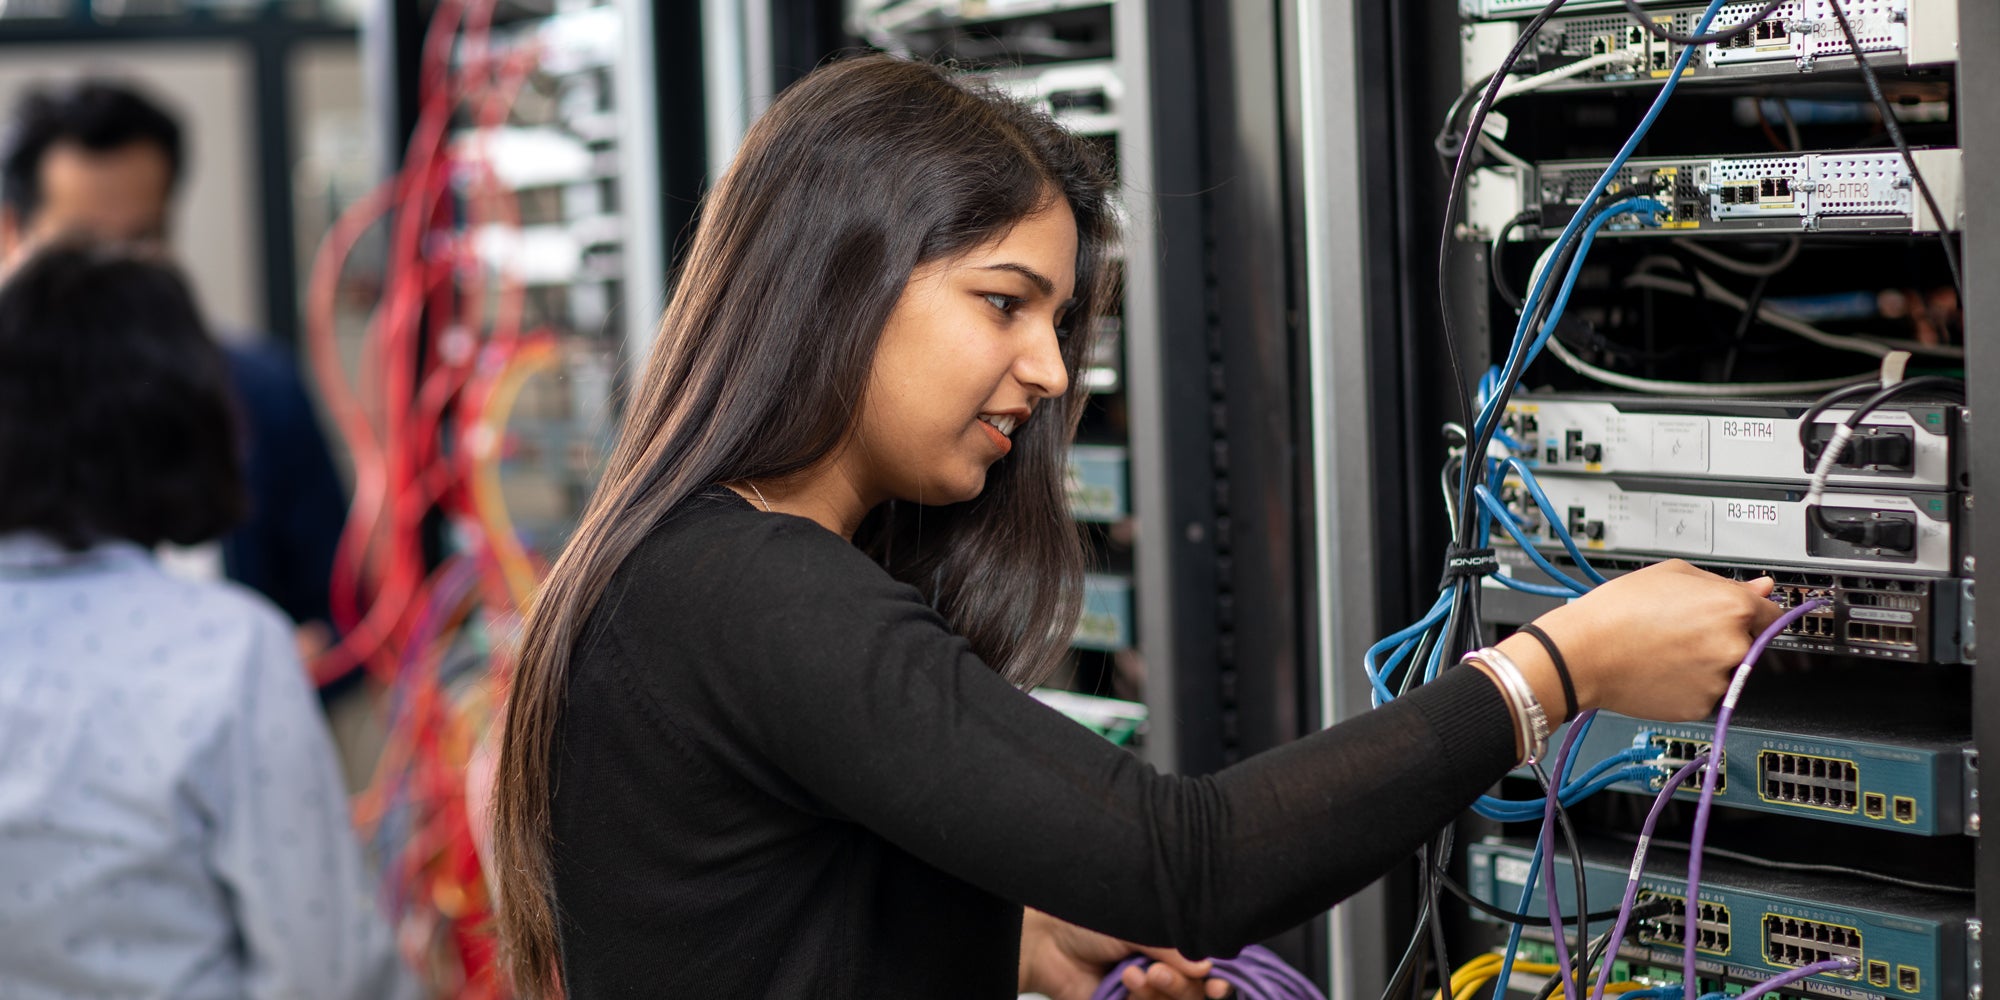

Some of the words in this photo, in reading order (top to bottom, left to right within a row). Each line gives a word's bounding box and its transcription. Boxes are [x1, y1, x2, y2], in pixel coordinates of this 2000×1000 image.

[1812, 19, 1864, 38] R3-RR2
[1817, 182, 1869, 199] R3-RTR3
[1723, 421, 1772, 438] R3-RTR4
[1728, 502, 1777, 521] R3-RTR5
